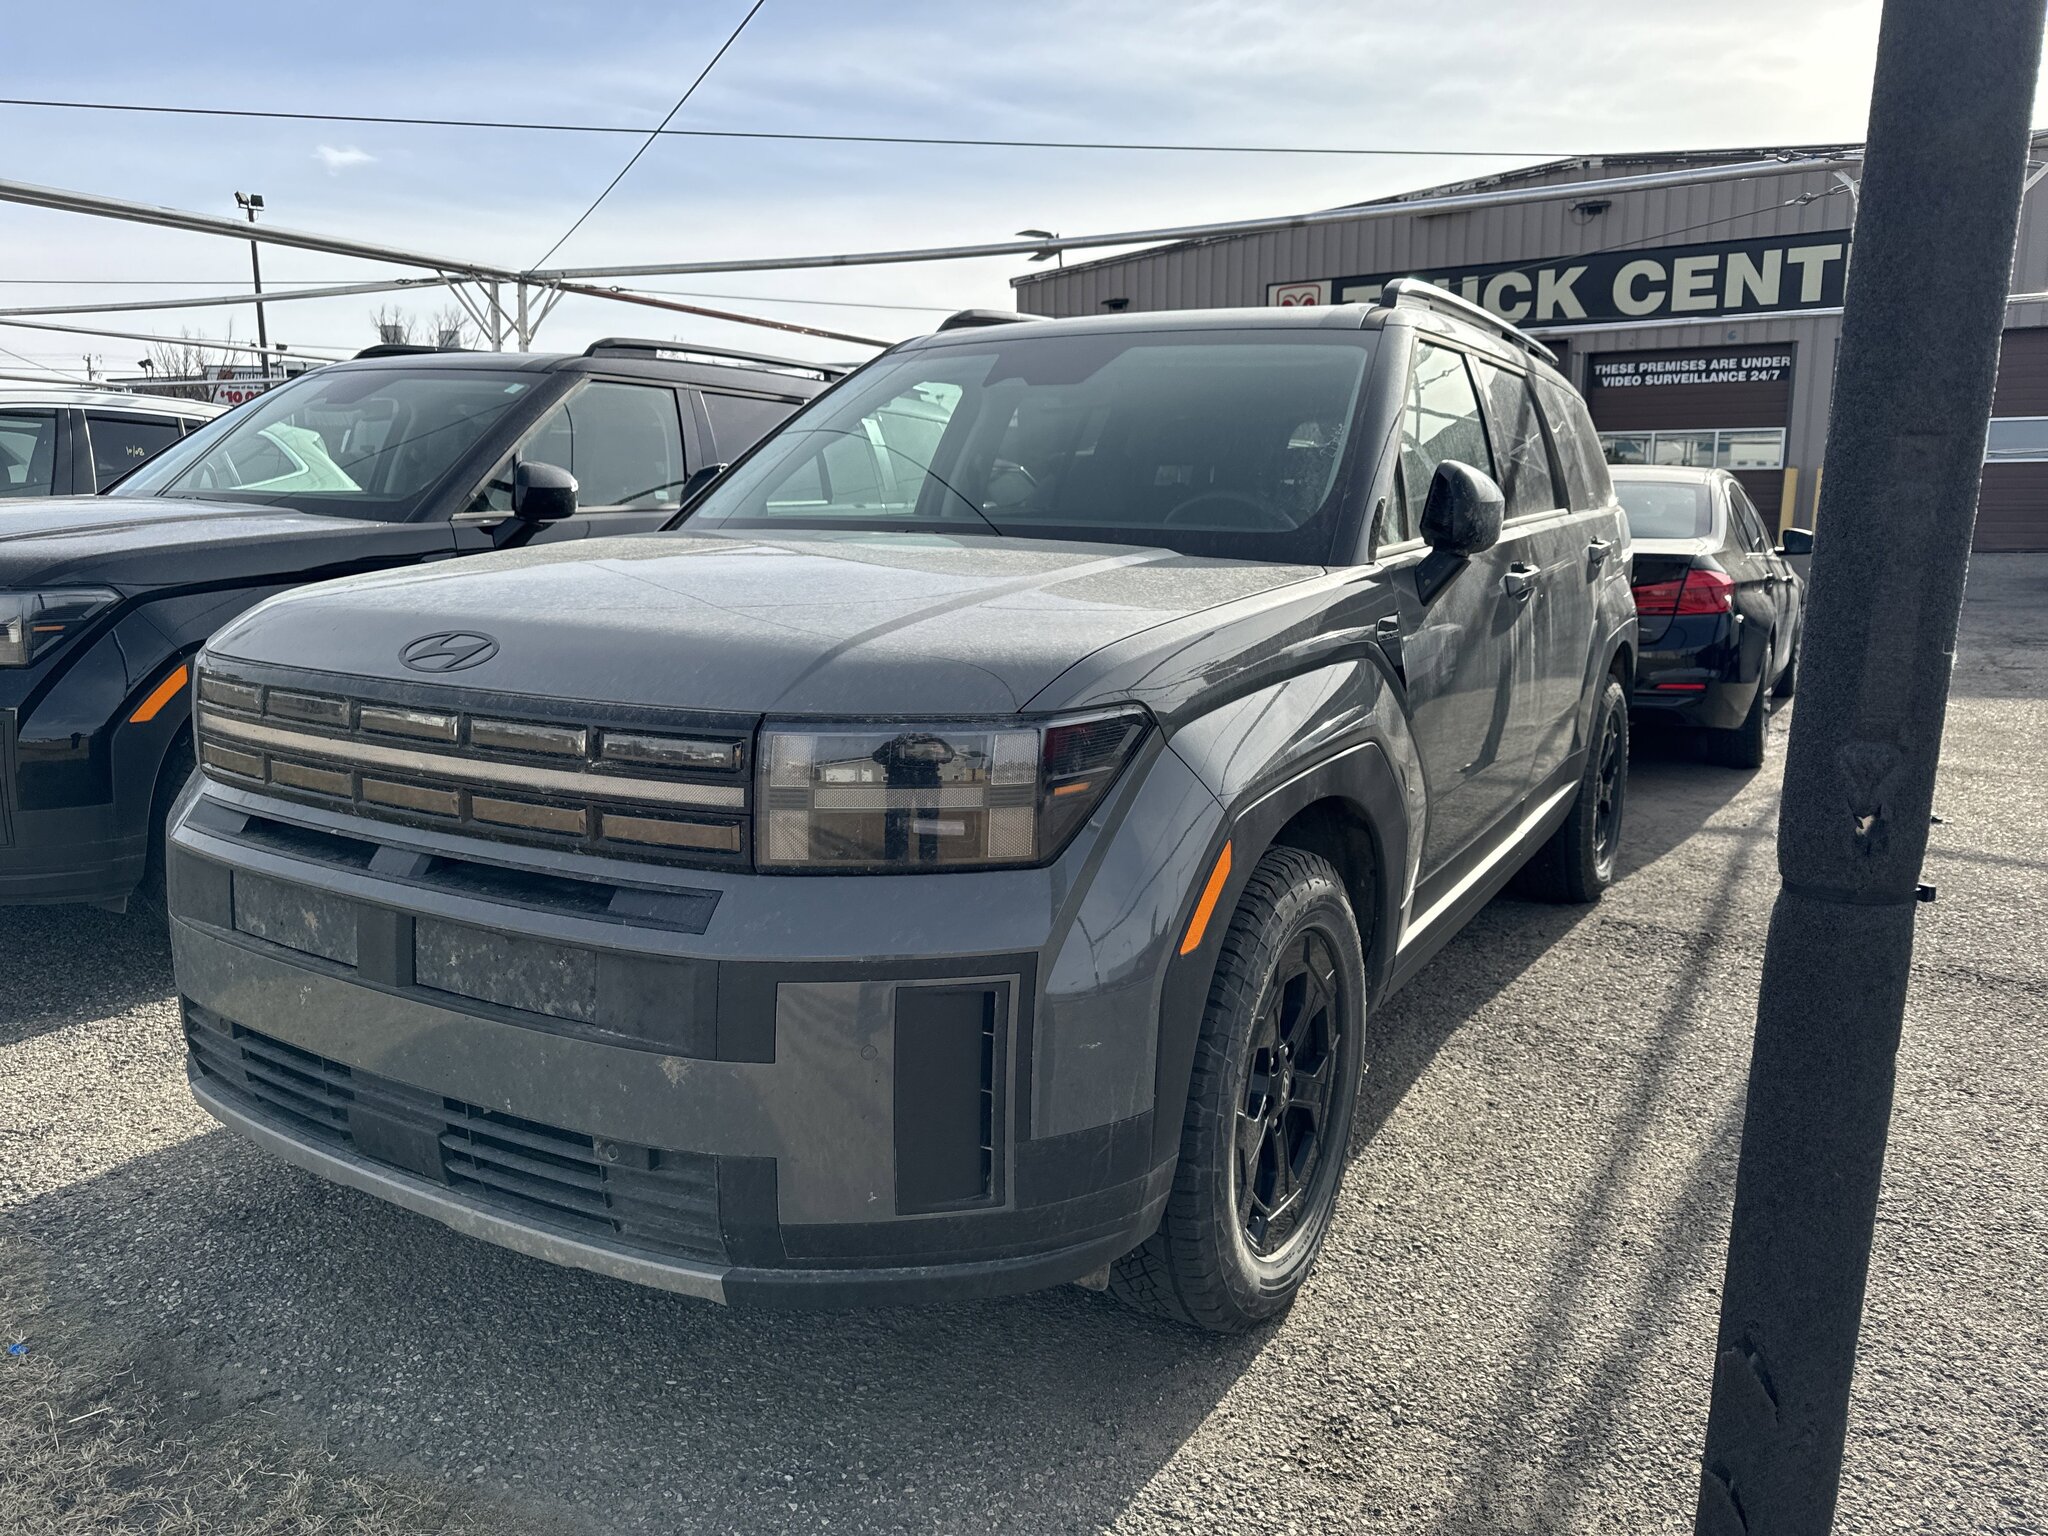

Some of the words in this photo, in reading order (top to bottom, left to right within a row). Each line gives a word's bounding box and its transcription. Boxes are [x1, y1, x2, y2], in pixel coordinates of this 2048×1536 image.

[1341, 265, 1589, 325] TUCK
[1612, 243, 1853, 316] CENT
[1594, 363, 1636, 375] THESE
[1639, 360, 1707, 373] PREMISES
[1709, 358, 1738, 370] ARE
[1741, 356, 1791, 368] UNDER
[1602, 375, 1642, 387] VIDEO
[1645, 371, 1747, 385] SURVEILLANCE
[1750, 370, 1781, 381] 24/7
